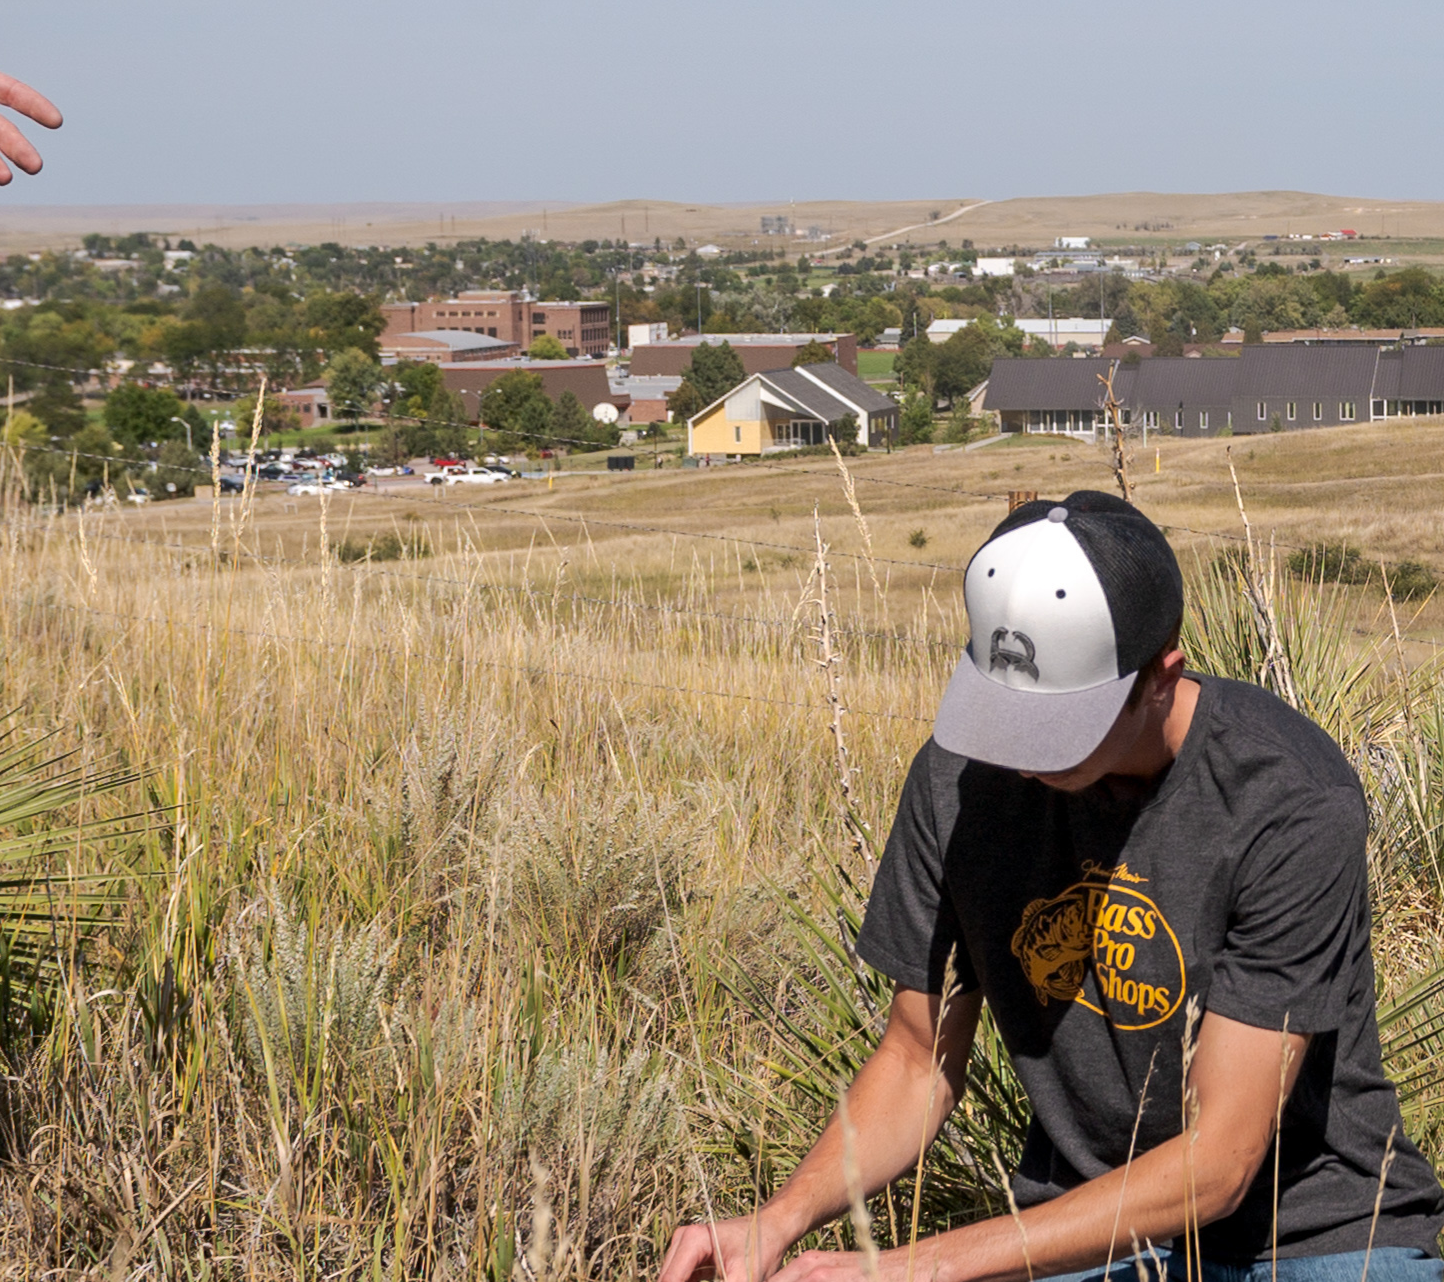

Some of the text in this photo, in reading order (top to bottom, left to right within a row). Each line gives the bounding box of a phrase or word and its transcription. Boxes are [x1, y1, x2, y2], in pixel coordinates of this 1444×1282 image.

[1086, 888, 1157, 940] Bass
[1093, 928, 1136, 971] Pro
[1096, 962, 1171, 1017] Shops
